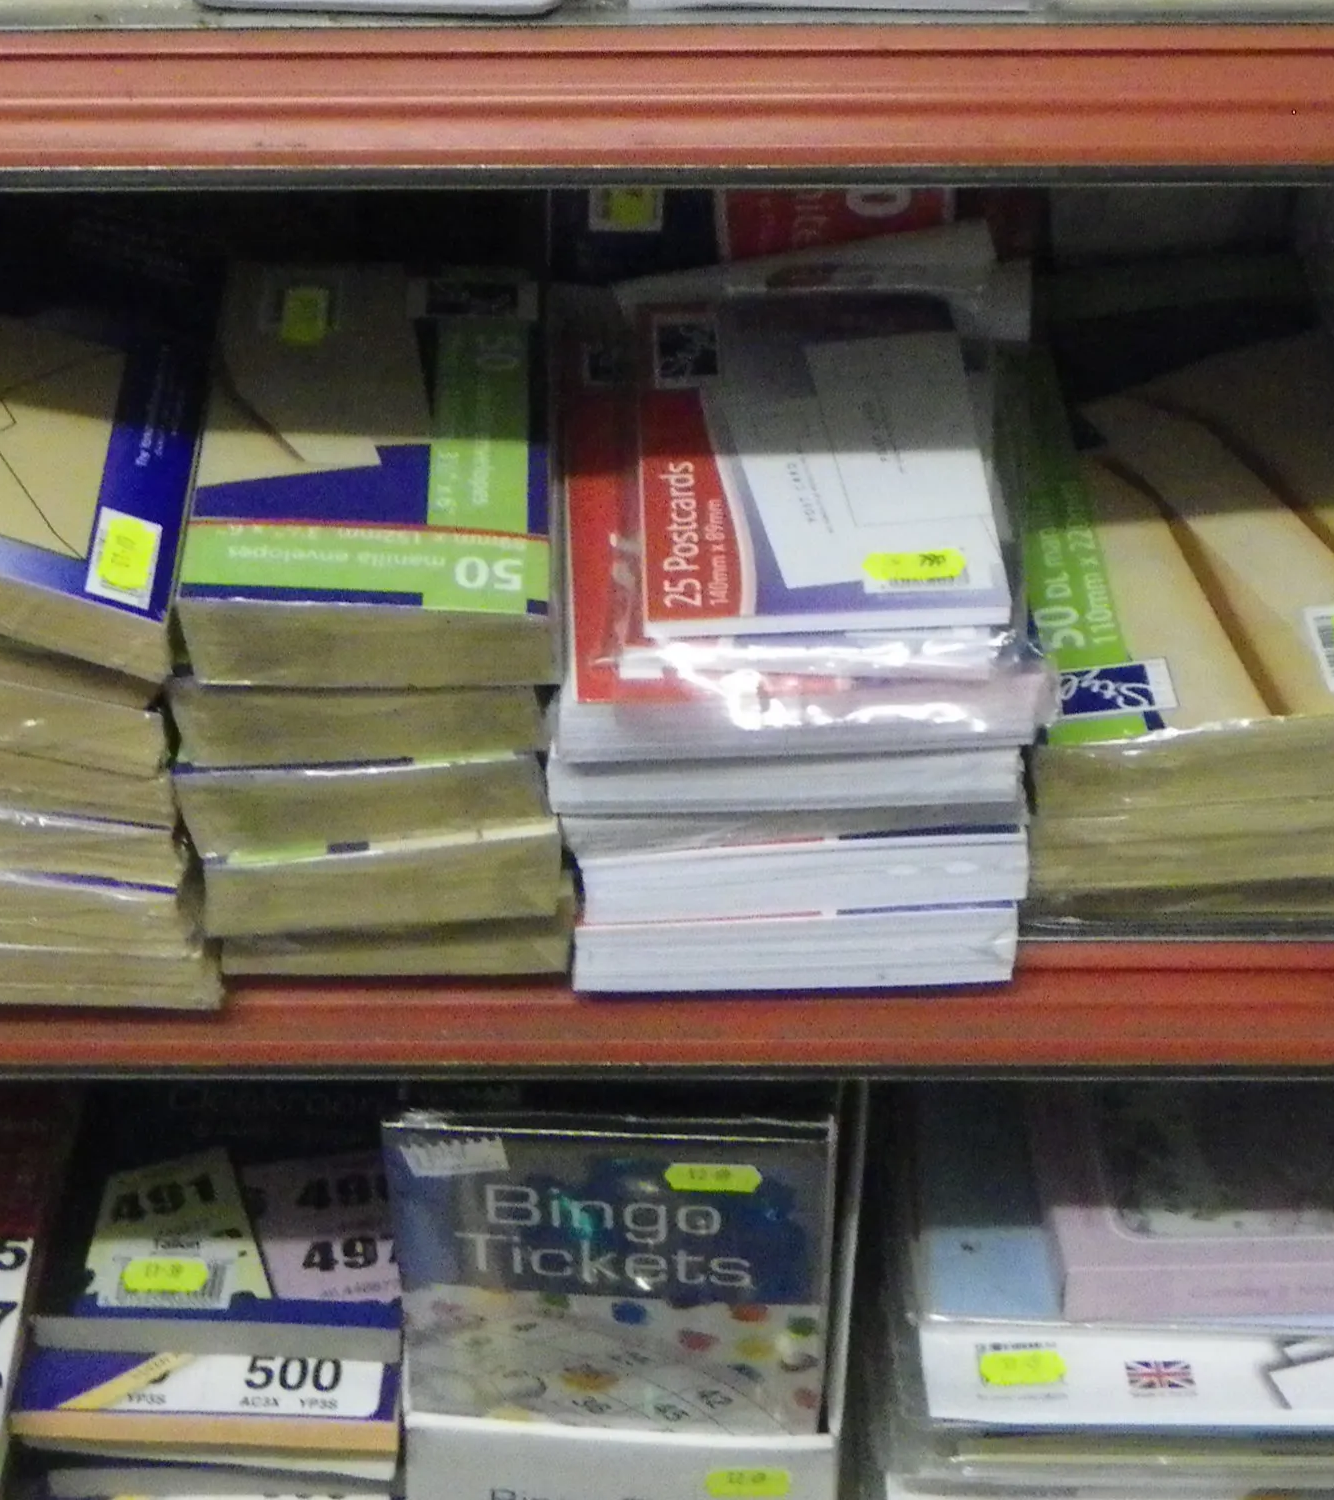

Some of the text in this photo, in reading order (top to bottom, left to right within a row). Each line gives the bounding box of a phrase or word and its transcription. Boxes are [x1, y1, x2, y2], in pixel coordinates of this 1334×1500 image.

[661, 461, 703, 609] 25 Postcards
[707, 499, 725, 542] 89mm
[227, 544, 524, 592] 50 manilla envelopes
[709, 554, 728, 607] 140mm
[1083, 571, 1117, 647] 110mm
[109, 1172, 219, 1224] 491
[482, 1183, 724, 1246] Bingo
[302, 1236, 398, 1274] 49
[454, 1230, 759, 1292] Tickets
[244, 1356, 344, 1394] 500
